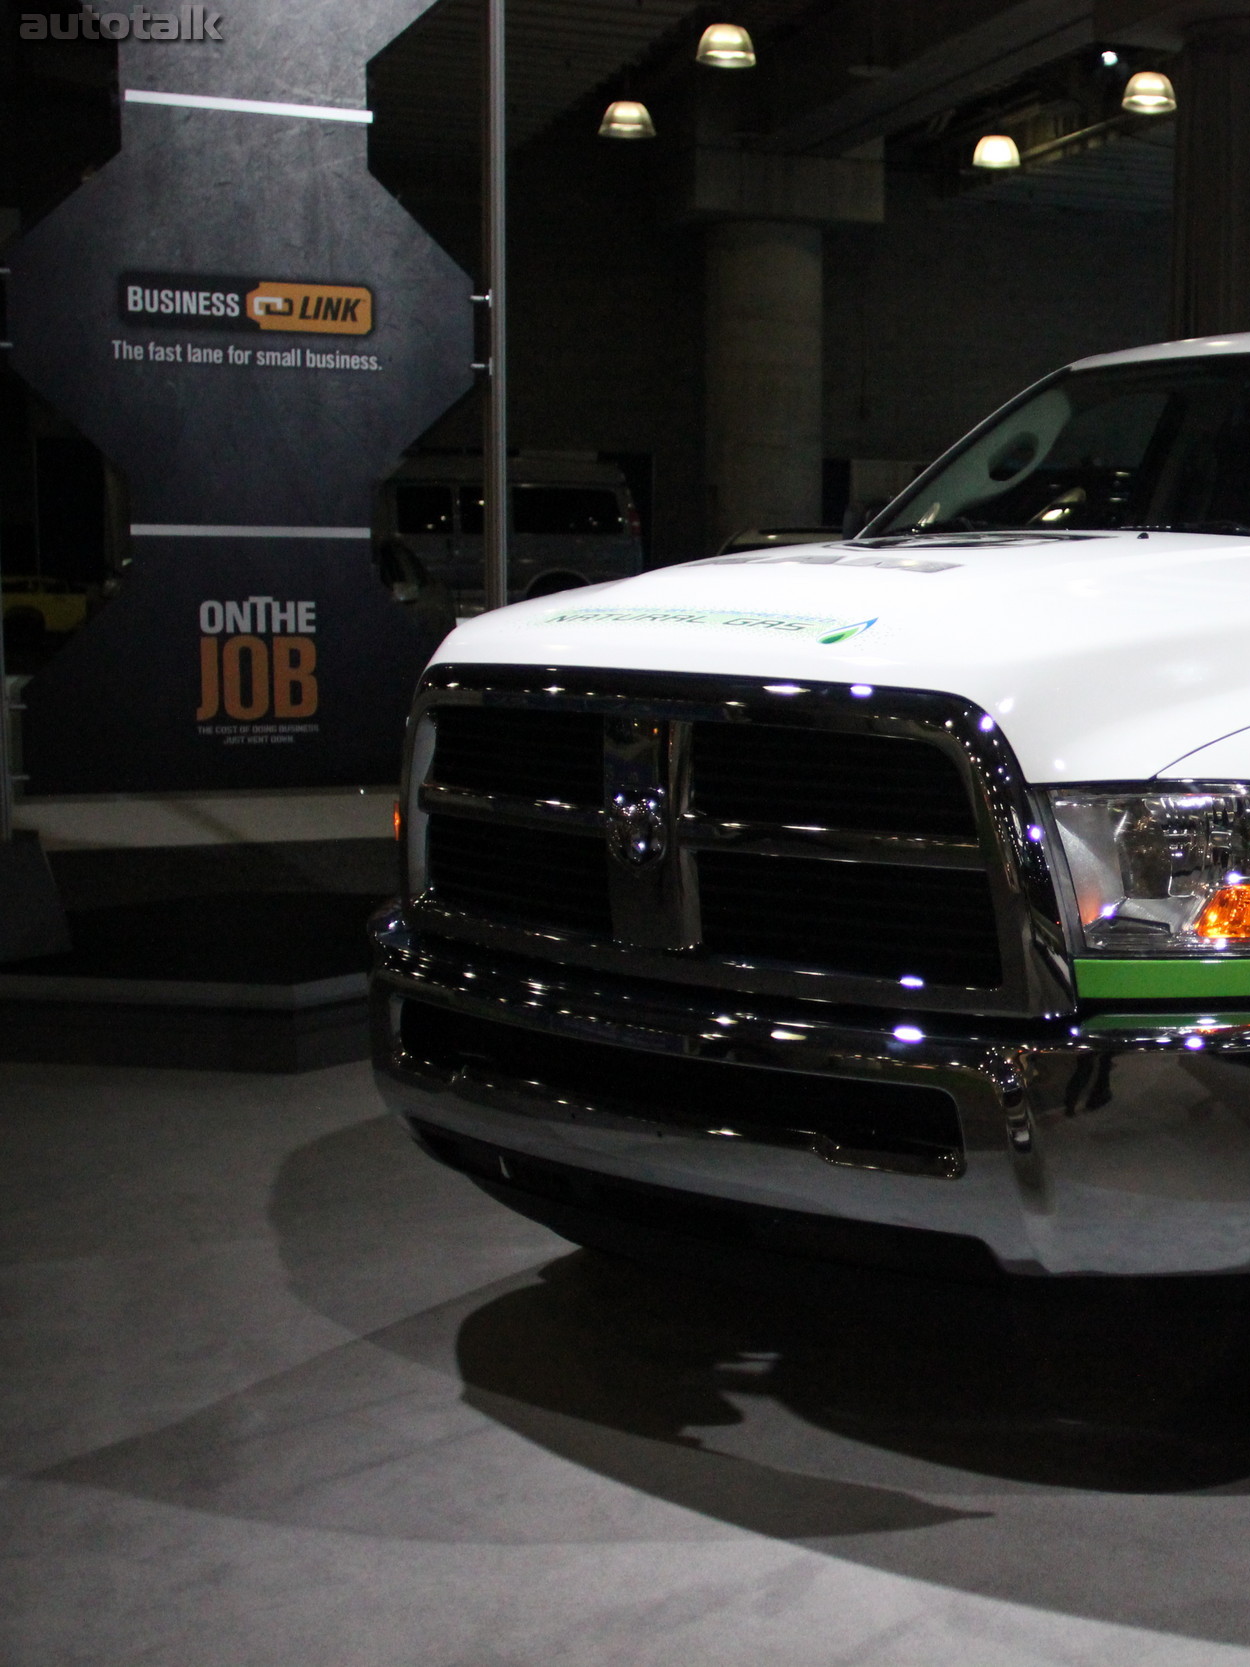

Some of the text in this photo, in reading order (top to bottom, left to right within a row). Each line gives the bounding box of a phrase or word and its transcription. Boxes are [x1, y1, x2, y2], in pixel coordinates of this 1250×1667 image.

[112, 340, 382, 371] The fast lane for small business.
[546, 613, 706, 624] NATURAL
[722, 618, 815, 631] GAS
[196, 635, 318, 721] JOB
